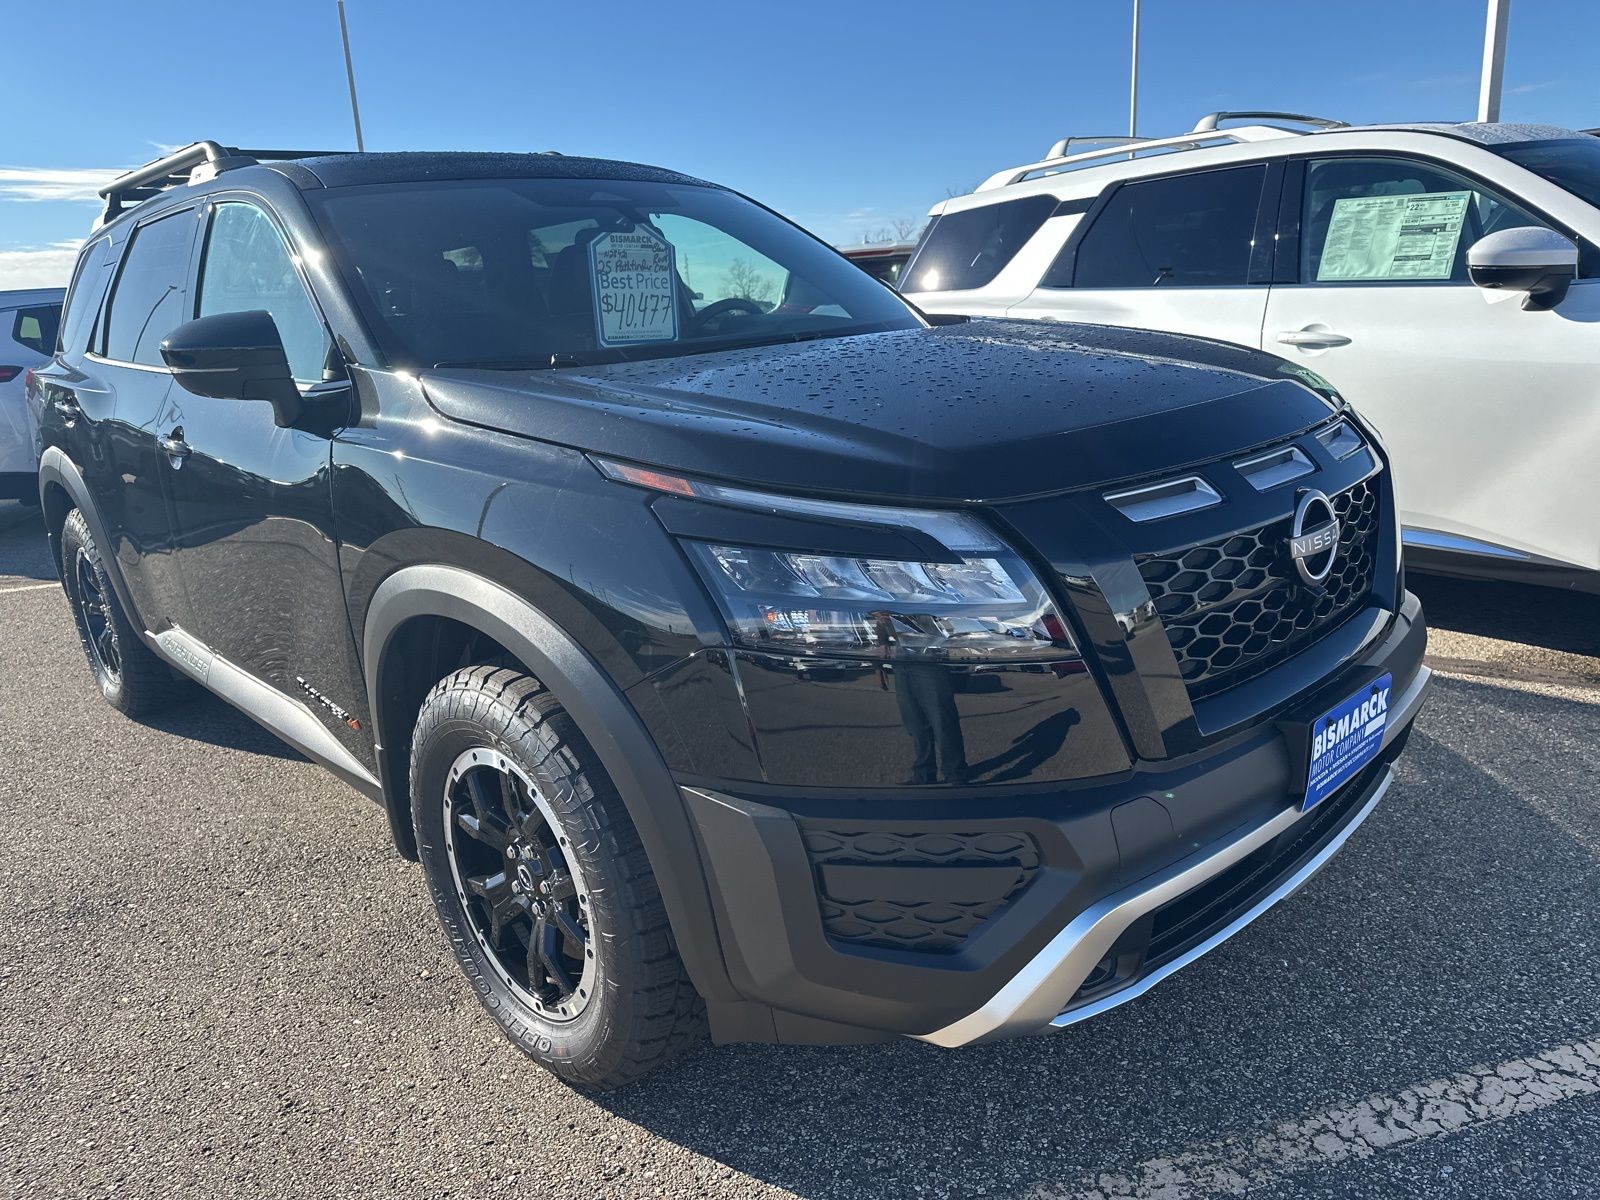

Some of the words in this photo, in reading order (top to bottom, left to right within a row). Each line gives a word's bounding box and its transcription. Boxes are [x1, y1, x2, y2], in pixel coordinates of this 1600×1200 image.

[610, 234, 653, 244] BISMARCK
[600, 272, 633, 290] Best
[636, 272, 669, 290] Price
[601, 292, 672, 330] $40,477
[1294, 529, 1338, 555] NISSA
[1313, 688, 1390, 761] BISMARCK
[1311, 750, 1335, 777] MOTOR
[1336, 727, 1367, 759] COMPANY
[500, 1008, 551, 1053] OPEN
